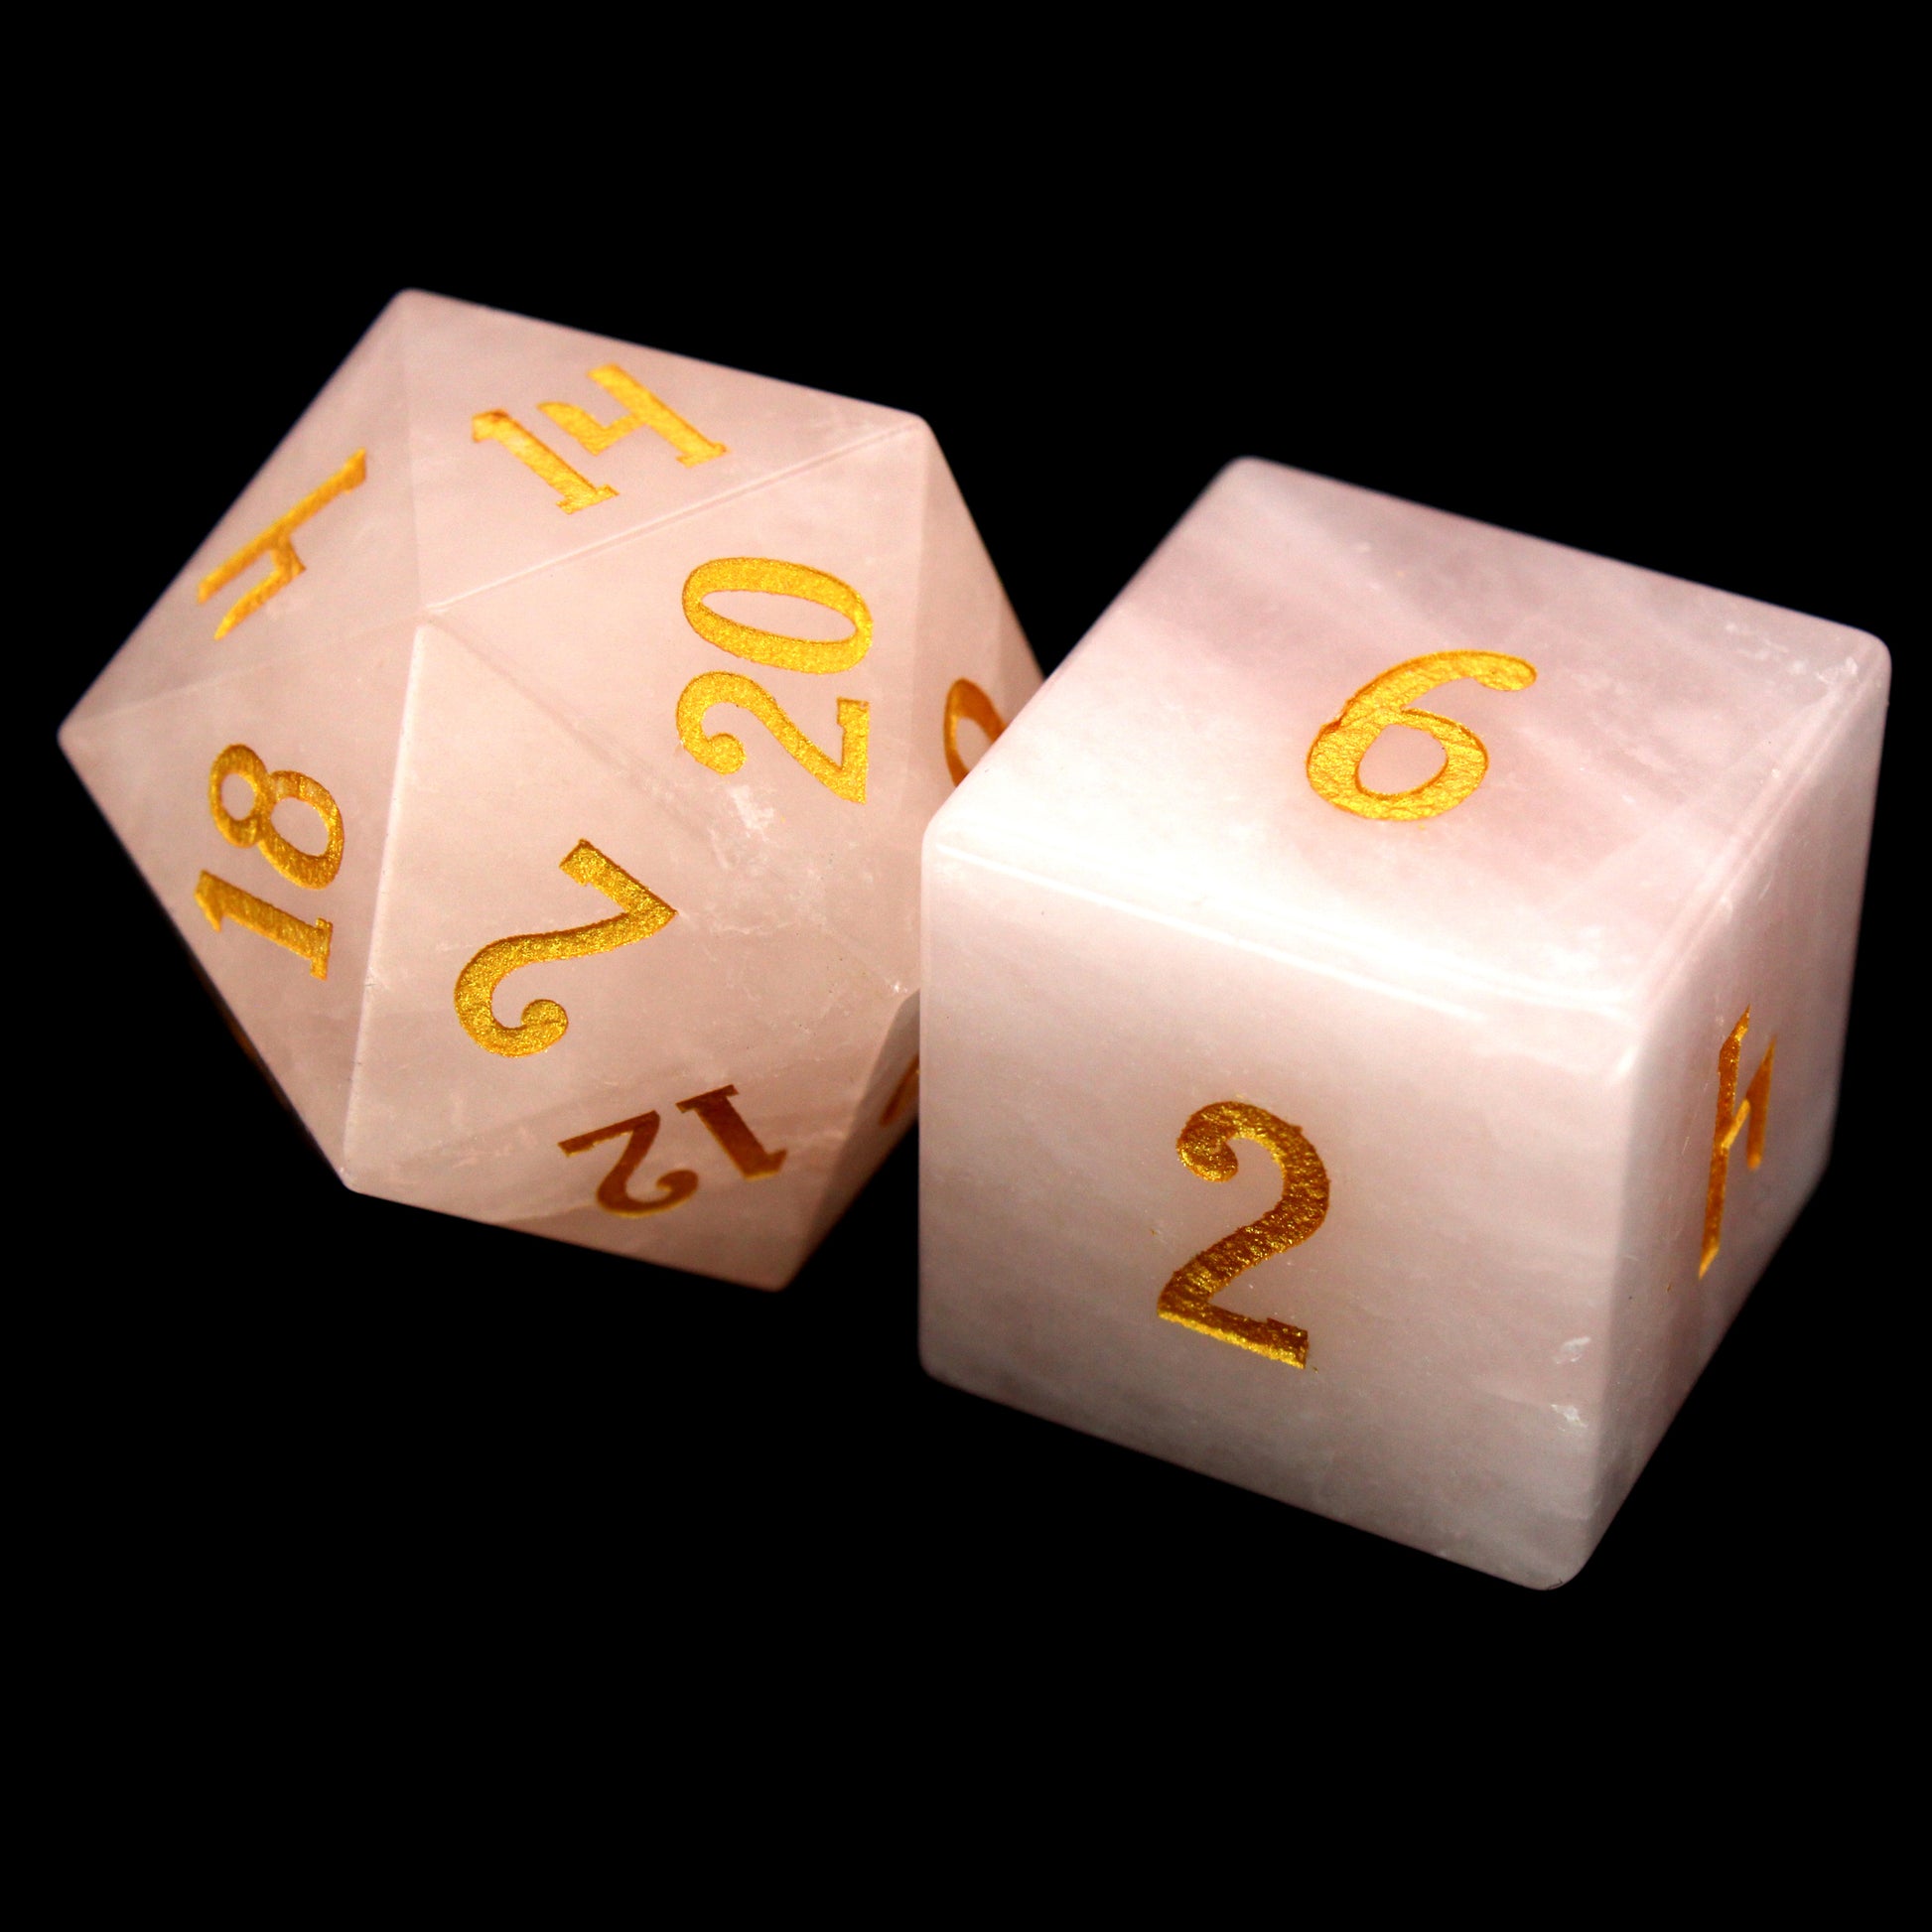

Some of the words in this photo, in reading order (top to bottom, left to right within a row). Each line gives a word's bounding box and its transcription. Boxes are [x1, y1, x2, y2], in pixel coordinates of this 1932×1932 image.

[197, 448, 367, 640] 4
[473, 363, 728, 514] 14
[675, 557, 873, 804] 20
[1306, 650, 1538, 822] 6
[194, 743, 345, 981] 18
[454, 838, 678, 1058] 2
[558, 1084, 786, 1219] 12
[1157, 1100, 1331, 1370] 2
[1699, 1005, 1777, 1280] 4
